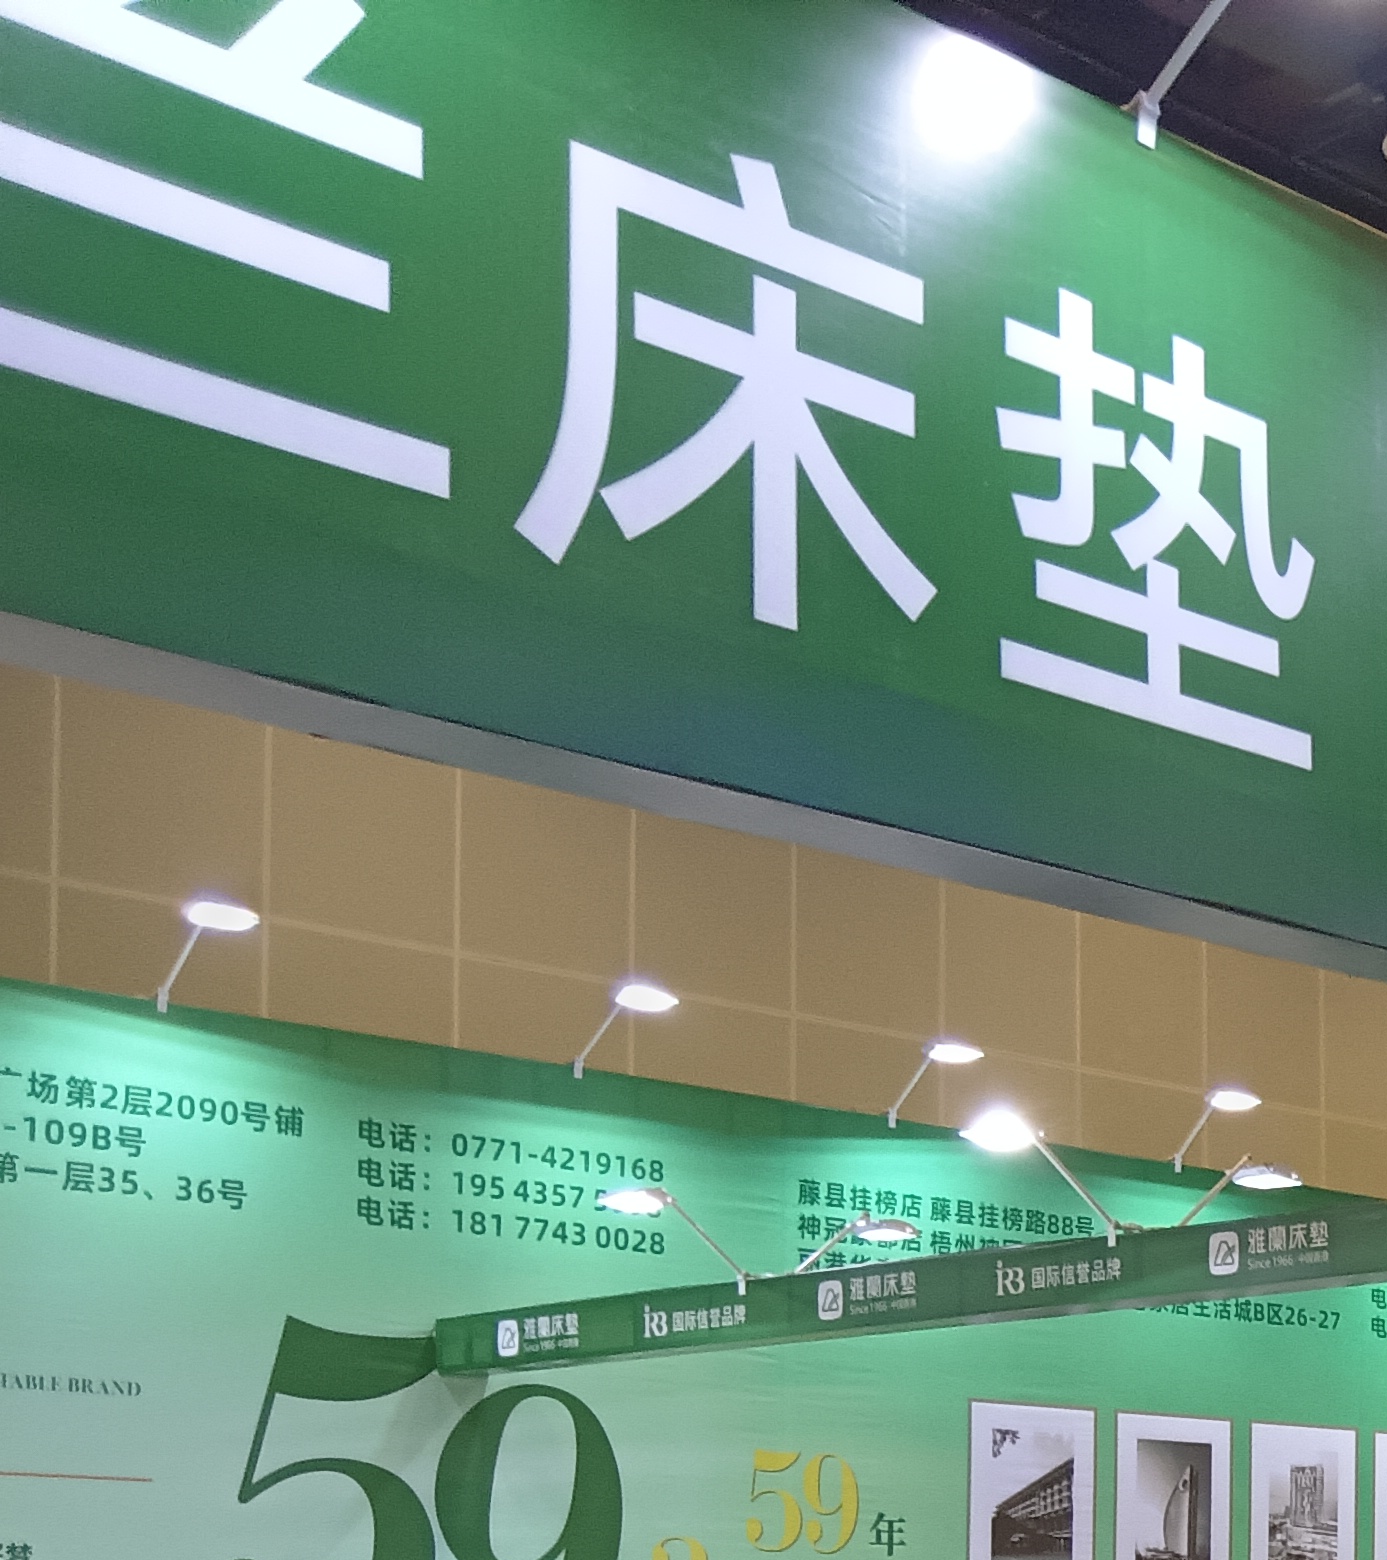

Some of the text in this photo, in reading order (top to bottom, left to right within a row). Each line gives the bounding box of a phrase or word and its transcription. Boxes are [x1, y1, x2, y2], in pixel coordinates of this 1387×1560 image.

[512, 1179, 585, 1209] 4357
[797, 1178, 1095, 1237] 藤县挂榜店 藤县挂榜路88号
[514, 1215, 586, 1246] 7743
[595, 1225, 666, 1255] 0028
[1030, 1258, 1122, 1291] 国际信誉品牌
[67, 1376, 142, 1397] BRAND
